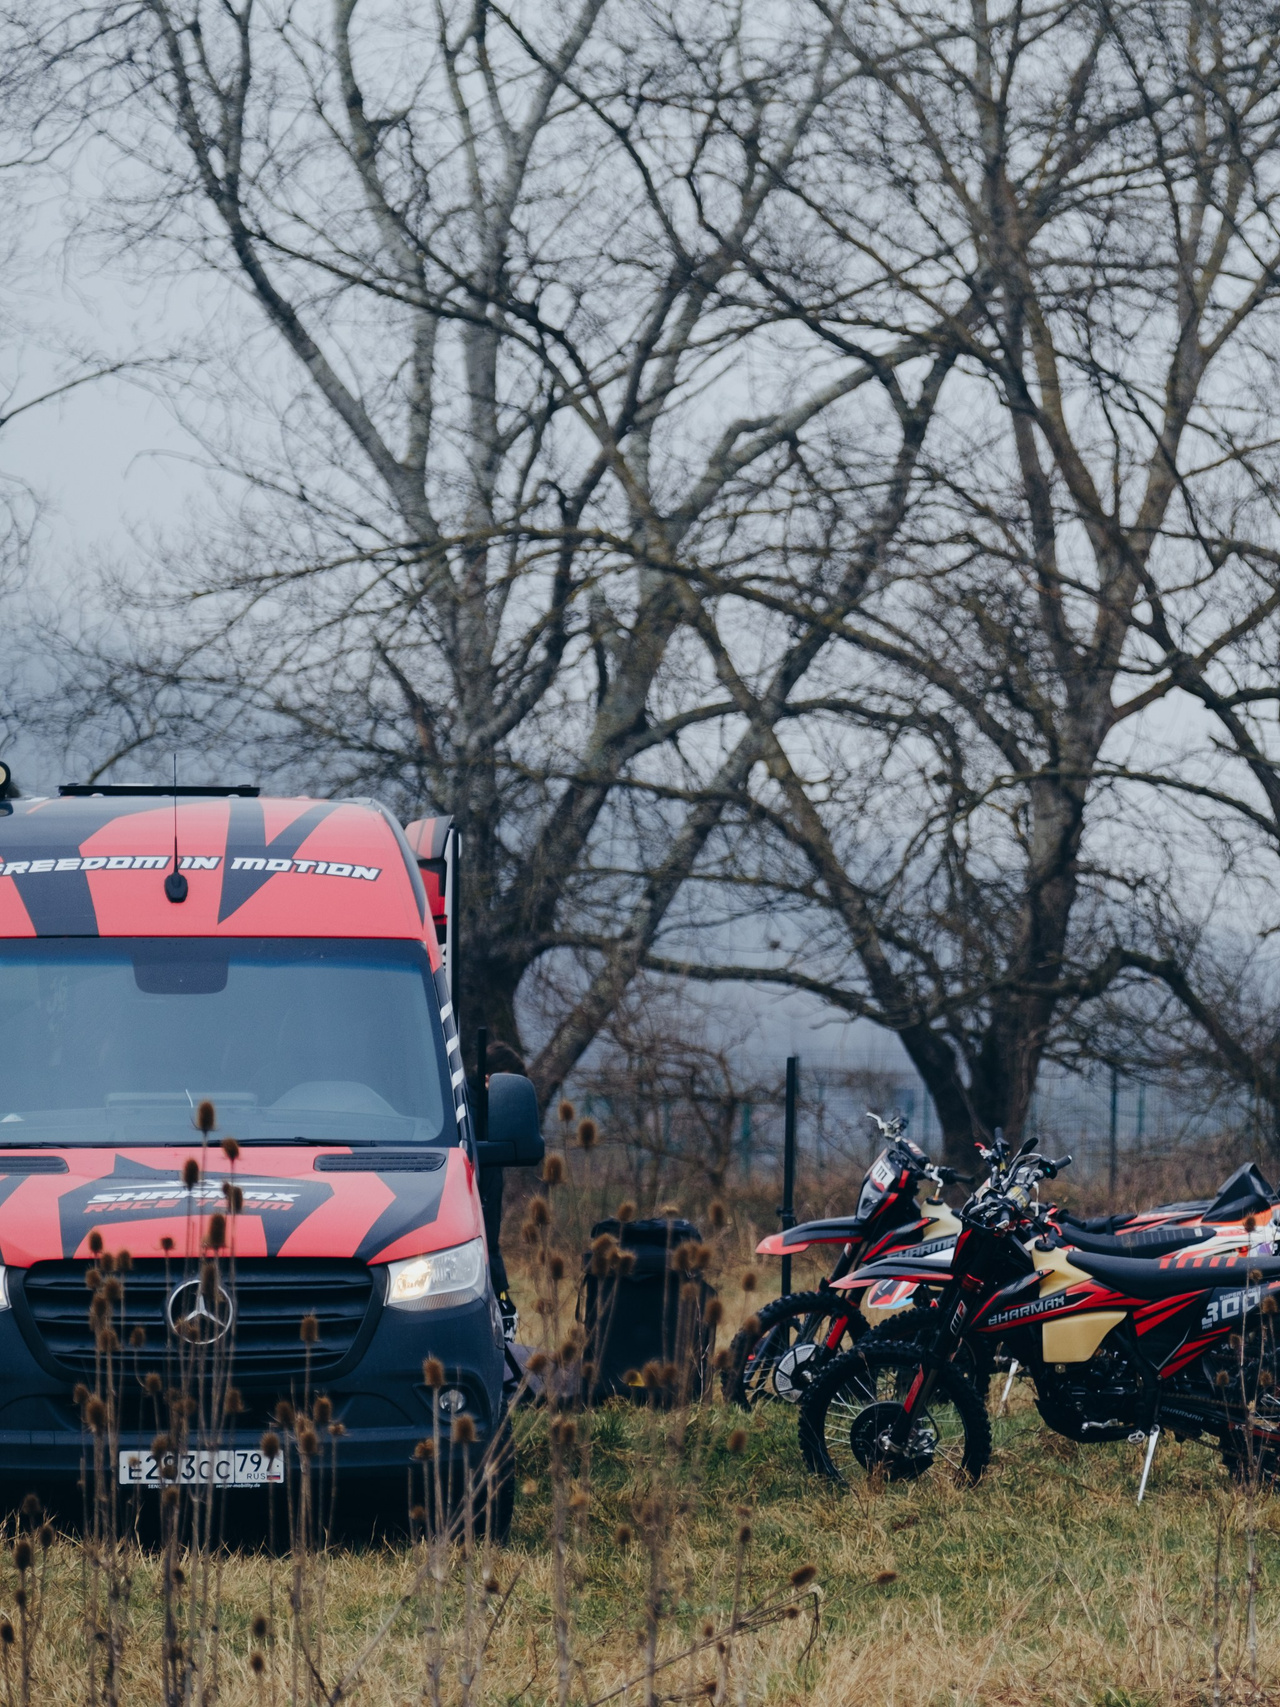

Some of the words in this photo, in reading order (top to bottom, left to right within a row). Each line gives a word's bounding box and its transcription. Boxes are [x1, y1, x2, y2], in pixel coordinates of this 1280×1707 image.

[0, 856, 171, 876] REEDOM
[179, 856, 220, 870] IN
[230, 857, 381, 881] MOTION
[83, 1200, 181, 1214] RACE
[197, 1198, 294, 1211] TEAM
[988, 1295, 1065, 1326] SHARMAX
[1201, 1292, 1261, 1325] 300
[246, 1472, 266, 1480] RUS
